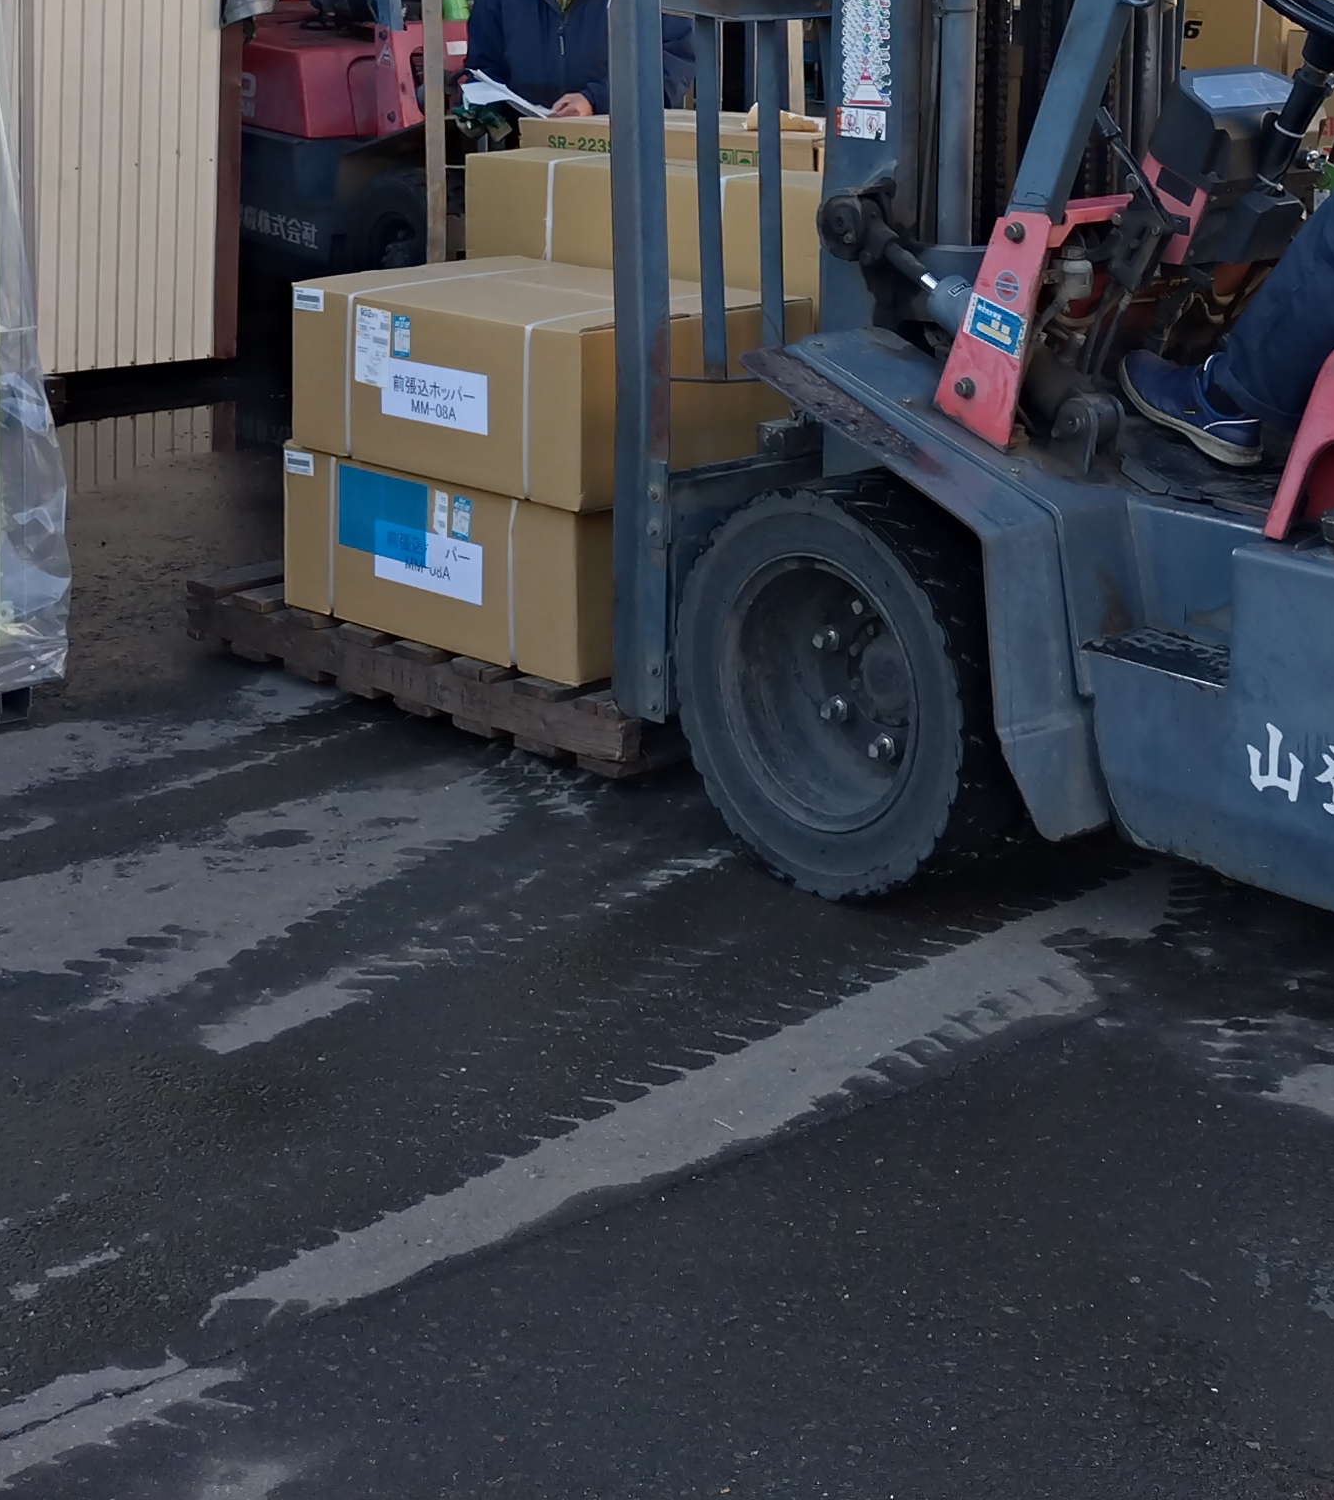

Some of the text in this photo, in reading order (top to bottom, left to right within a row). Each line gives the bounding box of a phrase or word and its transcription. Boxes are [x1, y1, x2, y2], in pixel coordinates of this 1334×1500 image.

[392, 374, 476, 402] 前張込ホッパー
[410, 398, 457, 422] MM-08A
[387, 530, 471, 562] 前張込パー
